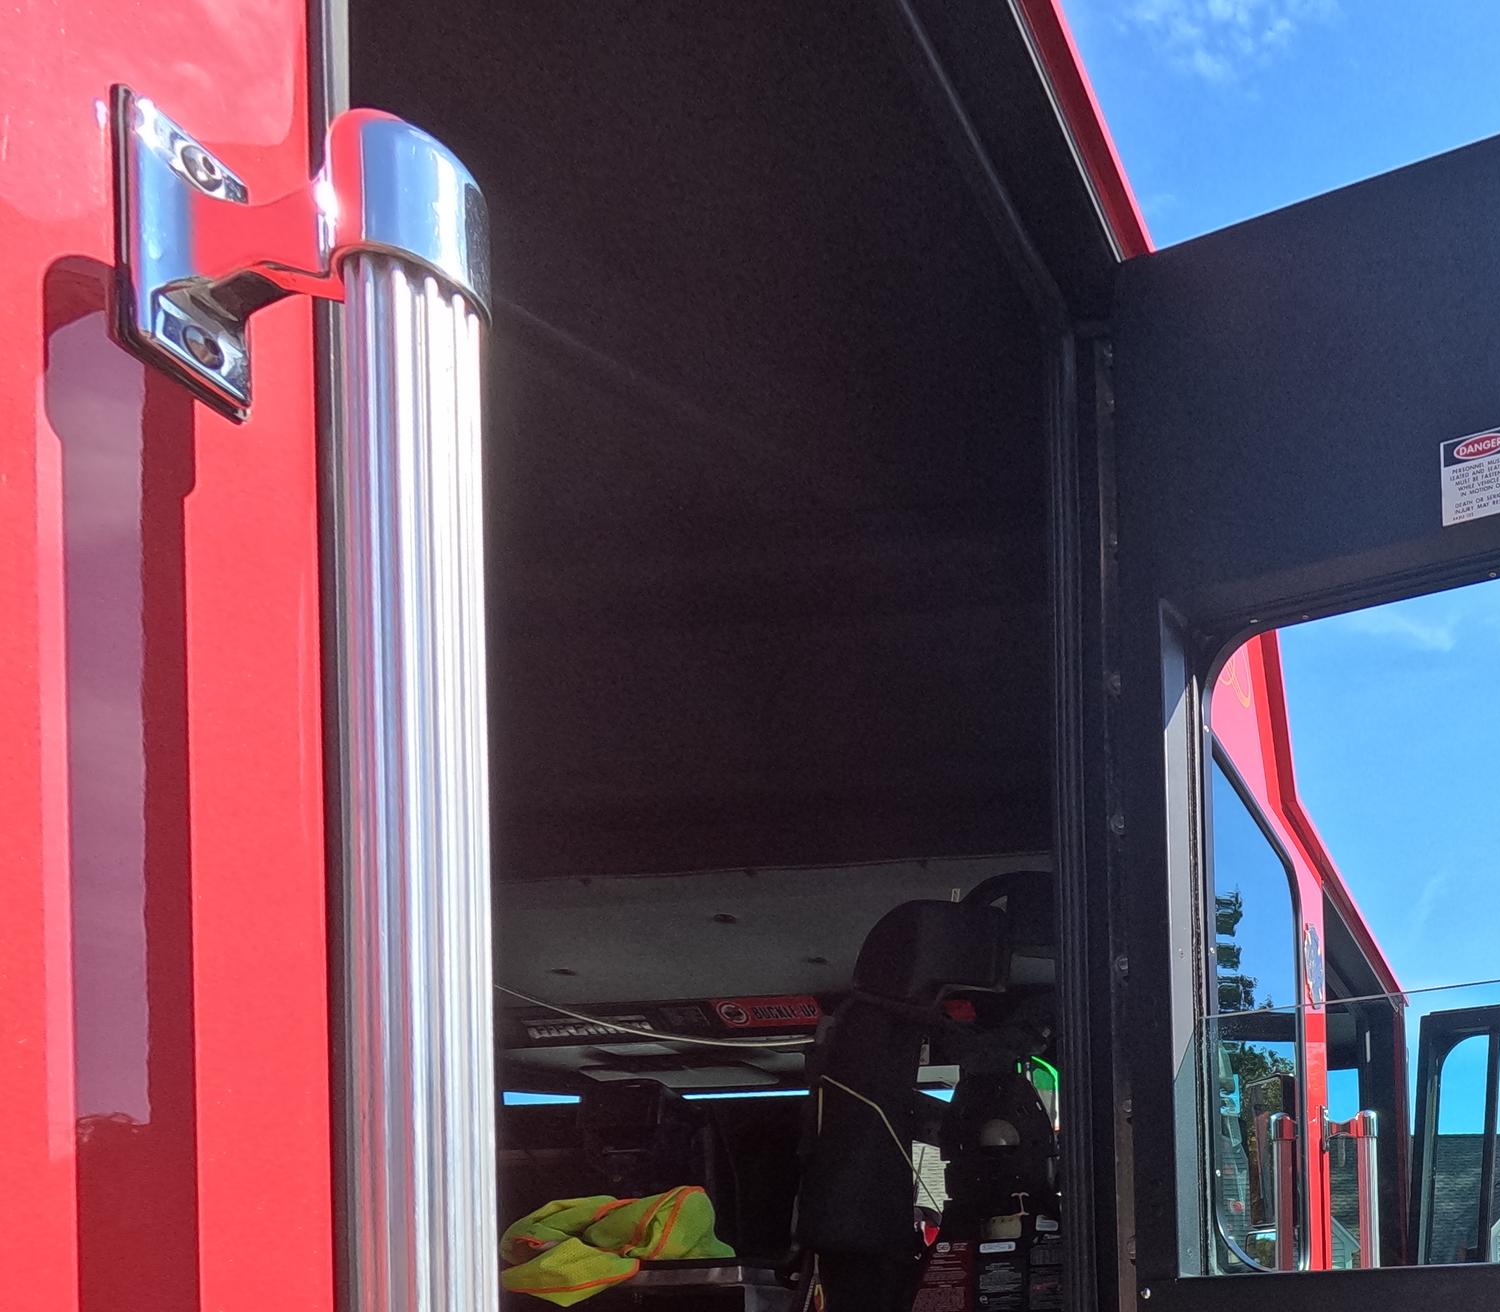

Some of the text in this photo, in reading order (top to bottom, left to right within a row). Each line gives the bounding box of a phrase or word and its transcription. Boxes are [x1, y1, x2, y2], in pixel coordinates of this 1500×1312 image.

[1452, 463, 1484, 474] PERSONNEL
[1478, 478, 1498, 486] VEHICLE
[1470, 486, 1493, 494] MOTION
